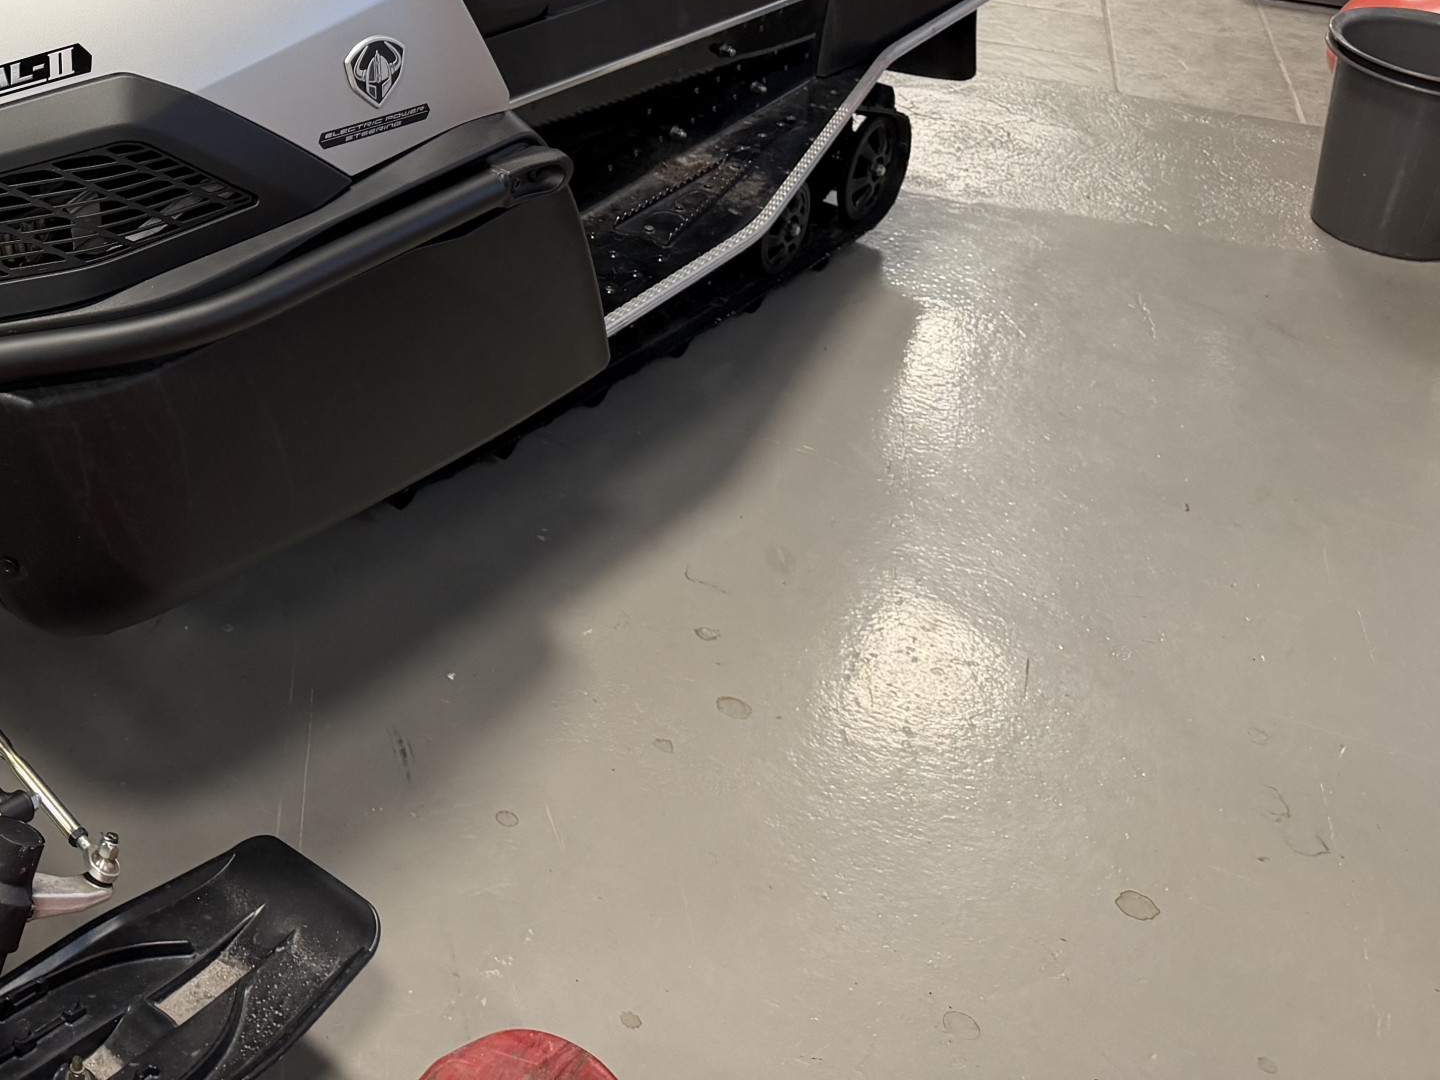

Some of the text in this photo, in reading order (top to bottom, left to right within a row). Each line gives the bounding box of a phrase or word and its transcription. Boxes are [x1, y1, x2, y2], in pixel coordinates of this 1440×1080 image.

[324, 105, 426, 139] ELECTRIC POWER
[344, 120, 403, 142] STEERING
